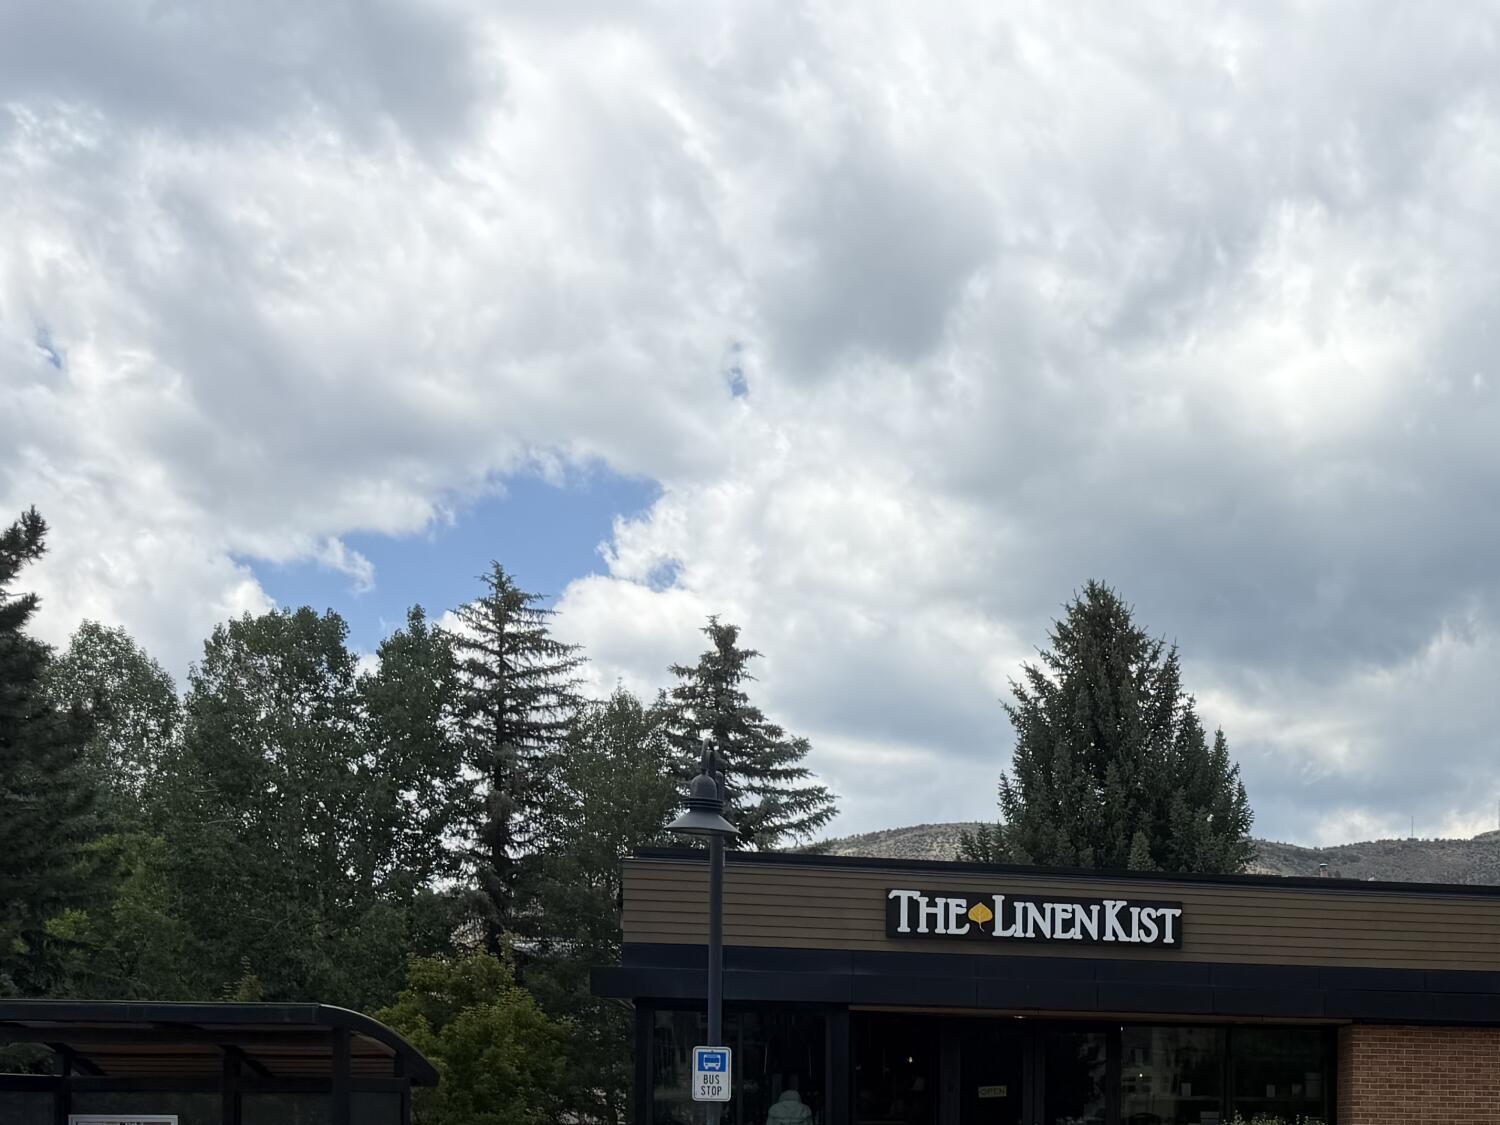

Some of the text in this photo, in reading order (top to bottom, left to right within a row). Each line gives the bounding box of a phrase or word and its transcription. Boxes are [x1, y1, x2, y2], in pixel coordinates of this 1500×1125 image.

[888, 889, 971, 935] THE
[703, 1074, 721, 1085] BUS
[700, 1085, 722, 1096] STOP
